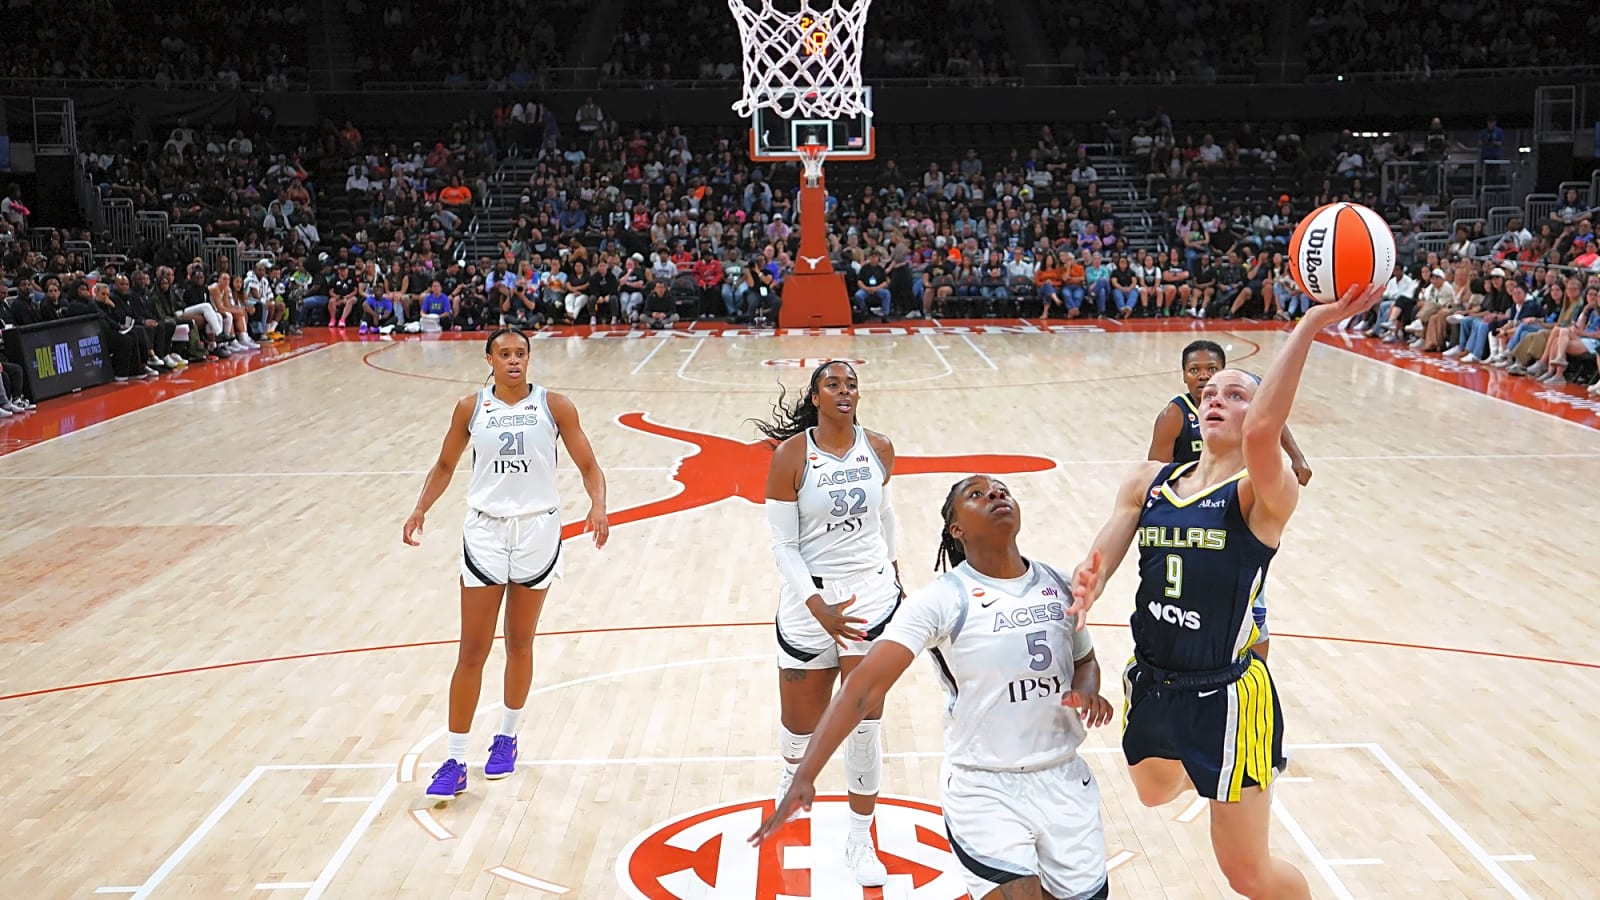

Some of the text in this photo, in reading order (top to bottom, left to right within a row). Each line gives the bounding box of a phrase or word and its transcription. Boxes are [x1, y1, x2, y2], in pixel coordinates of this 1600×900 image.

[1306, 227, 1328, 294] Wilson
[529, 324, 1107, 339] LONGHORNS
[35, 346, 56, 379] DAL
[55, 342, 73, 375] ATL
[486, 414, 538, 429] ACES
[499, 431, 525, 456] 21
[493, 459, 532, 474] IPSY
[817, 466, 872, 488] ACES
[828, 487, 868, 517] 32
[1198, 499, 1227, 508] Albert
[1164, 553, 1183, 599] 9
[1041, 587, 1058, 598] ally
[993, 602, 1065, 632] ACES
[1162, 604, 1201, 630] CVS
[1025, 630, 1053, 671] 5
[1008, 675, 1066, 703] IPSY
